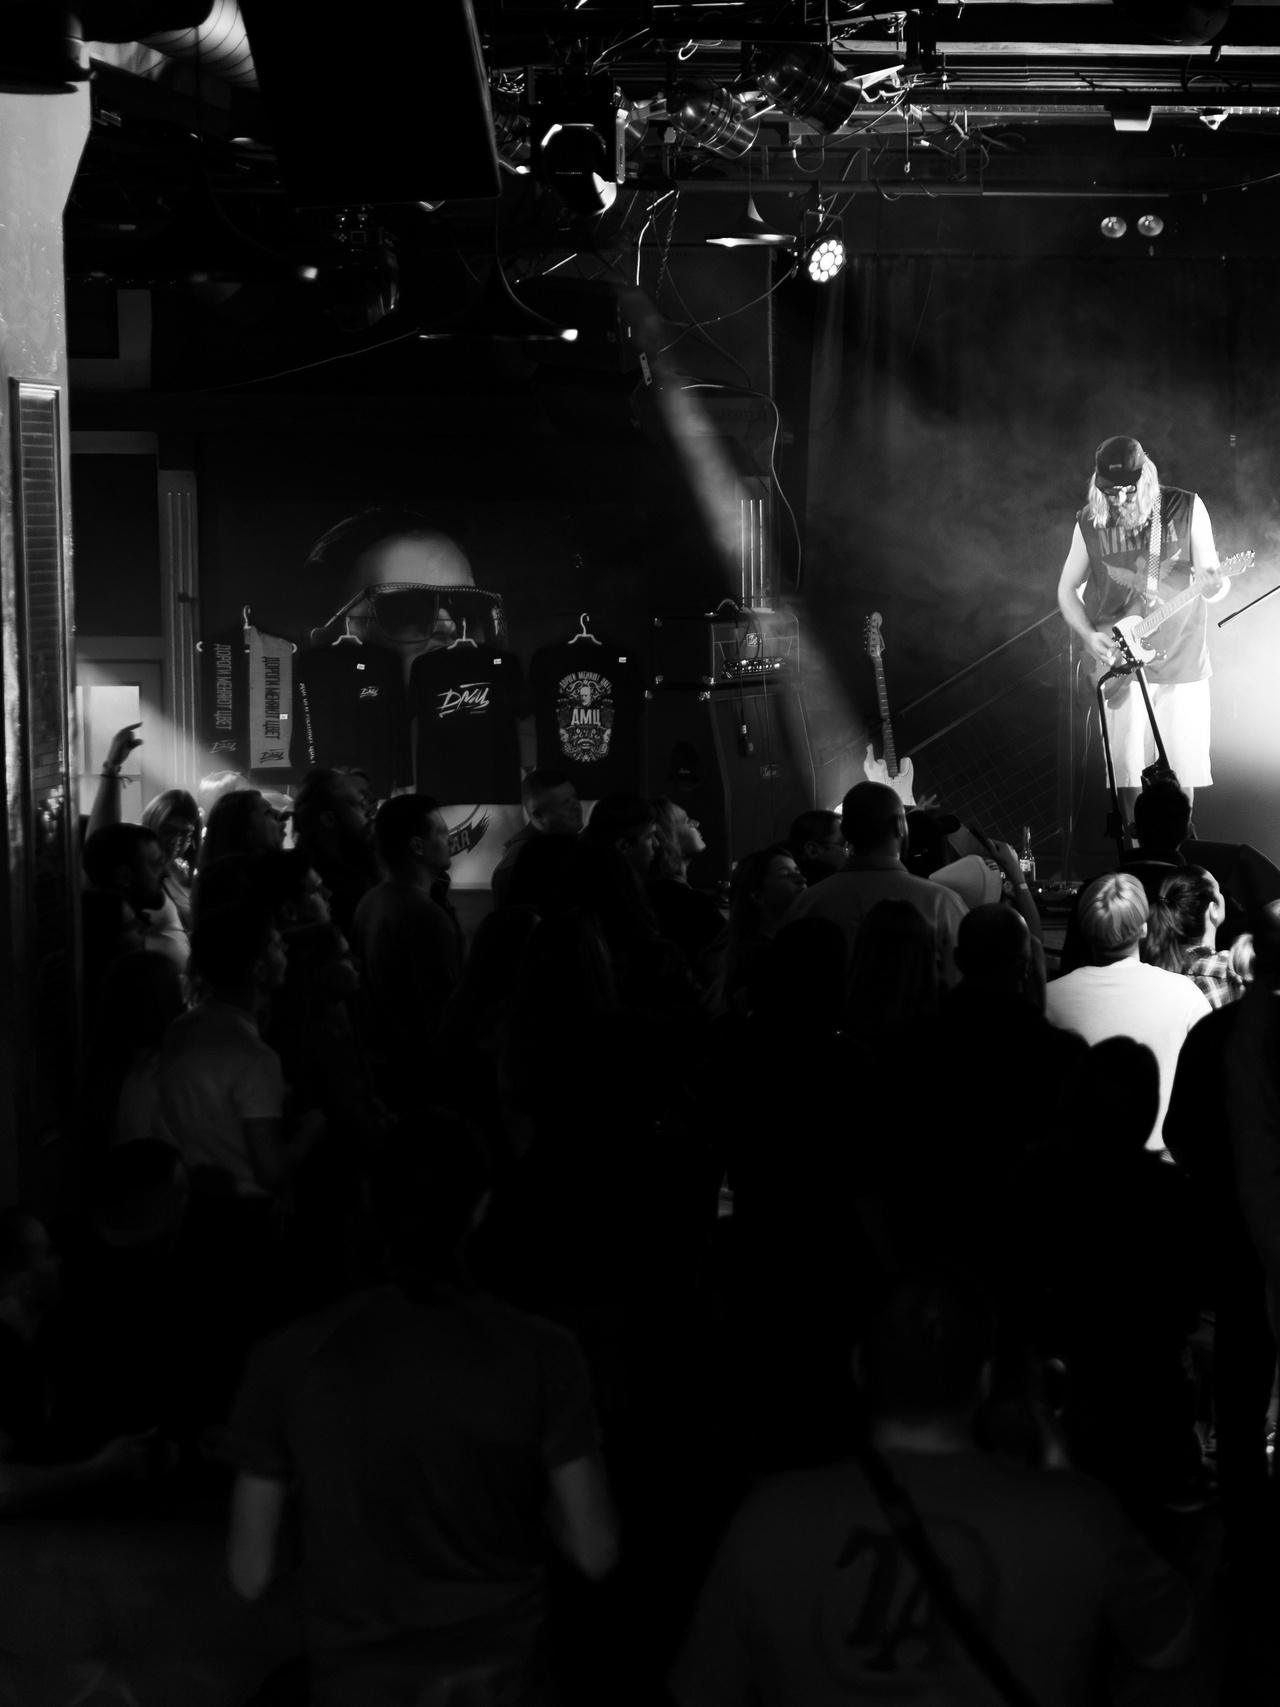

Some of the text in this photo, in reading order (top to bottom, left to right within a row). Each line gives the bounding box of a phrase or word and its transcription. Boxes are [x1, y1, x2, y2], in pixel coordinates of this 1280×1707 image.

[213, 643, 232, 675] ДОРОГИ
[261, 656, 280, 686] ДОРОГИ
[213, 710, 232, 730] ЦВЕТ
[262, 720, 280, 740] ЦВЕТ
